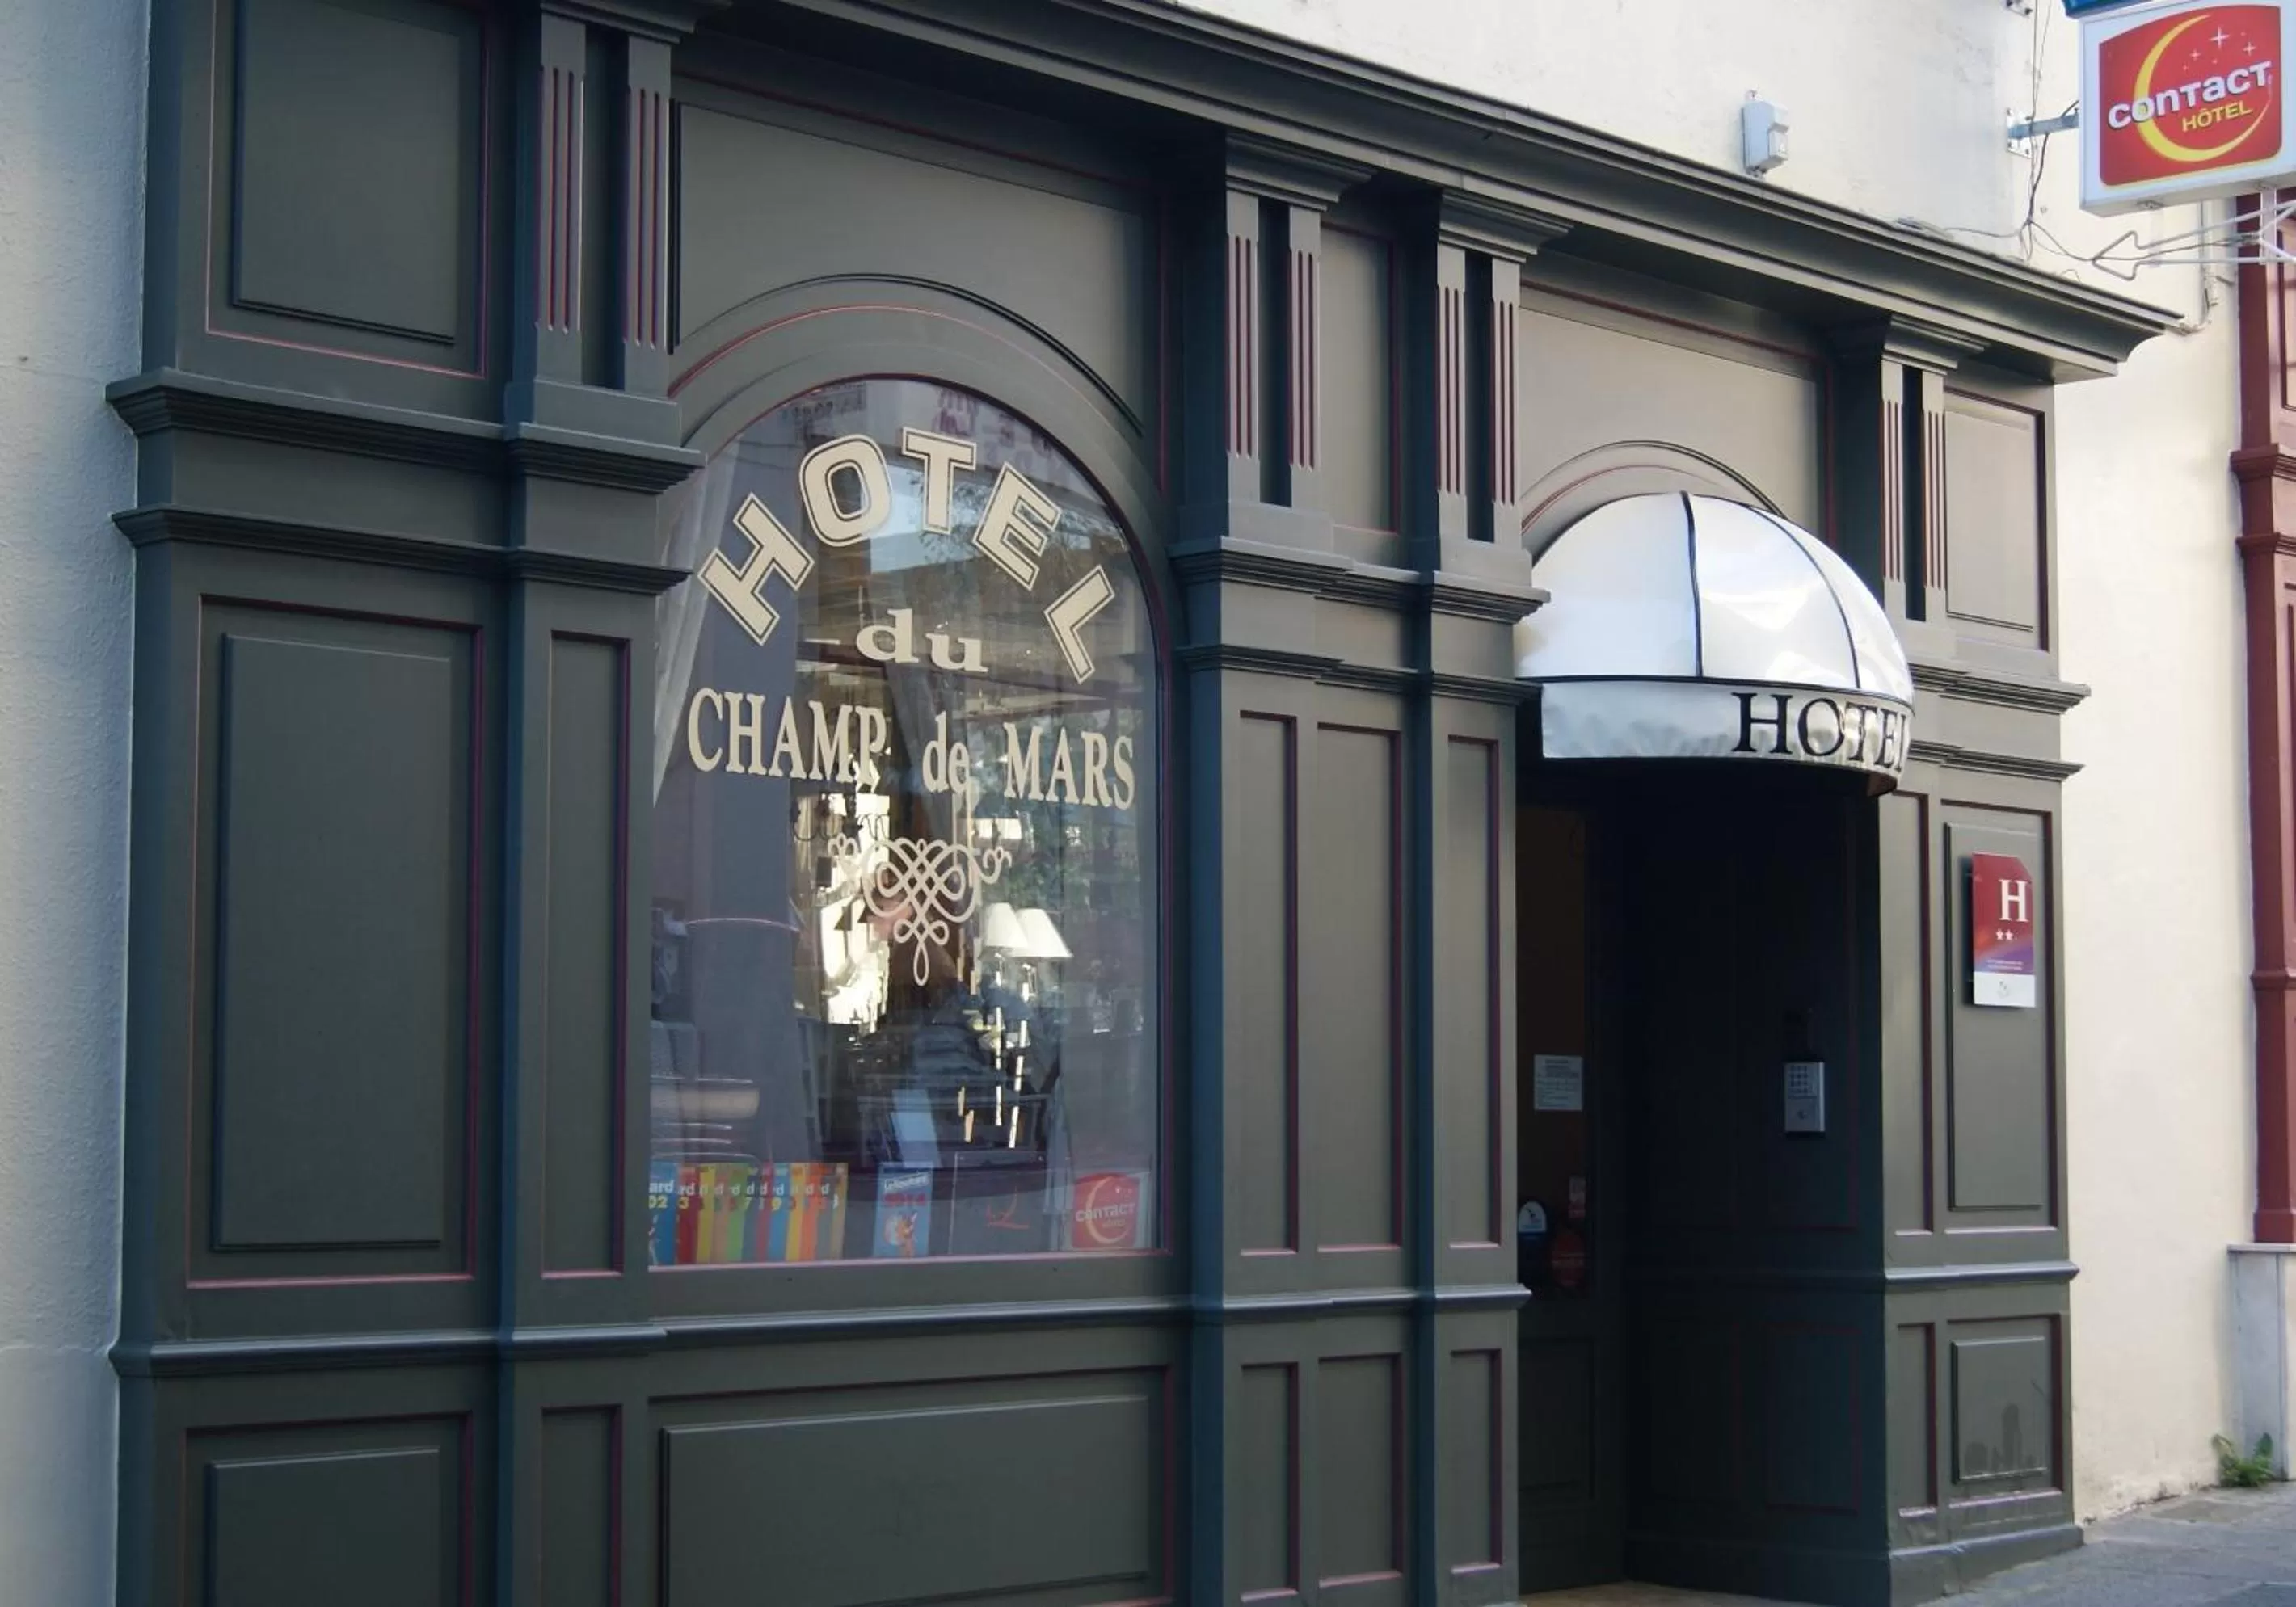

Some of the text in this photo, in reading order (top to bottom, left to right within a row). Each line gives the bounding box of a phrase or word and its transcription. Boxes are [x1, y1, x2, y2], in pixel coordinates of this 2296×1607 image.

[2182, 100, 2253, 133] HÔTEL
[697, 426, 1115, 684] HOTEL
[856, 608, 989, 672] du
[689, 688, 1135, 810] CHAMP de MARS
[1999, 879, 2028, 922] H
